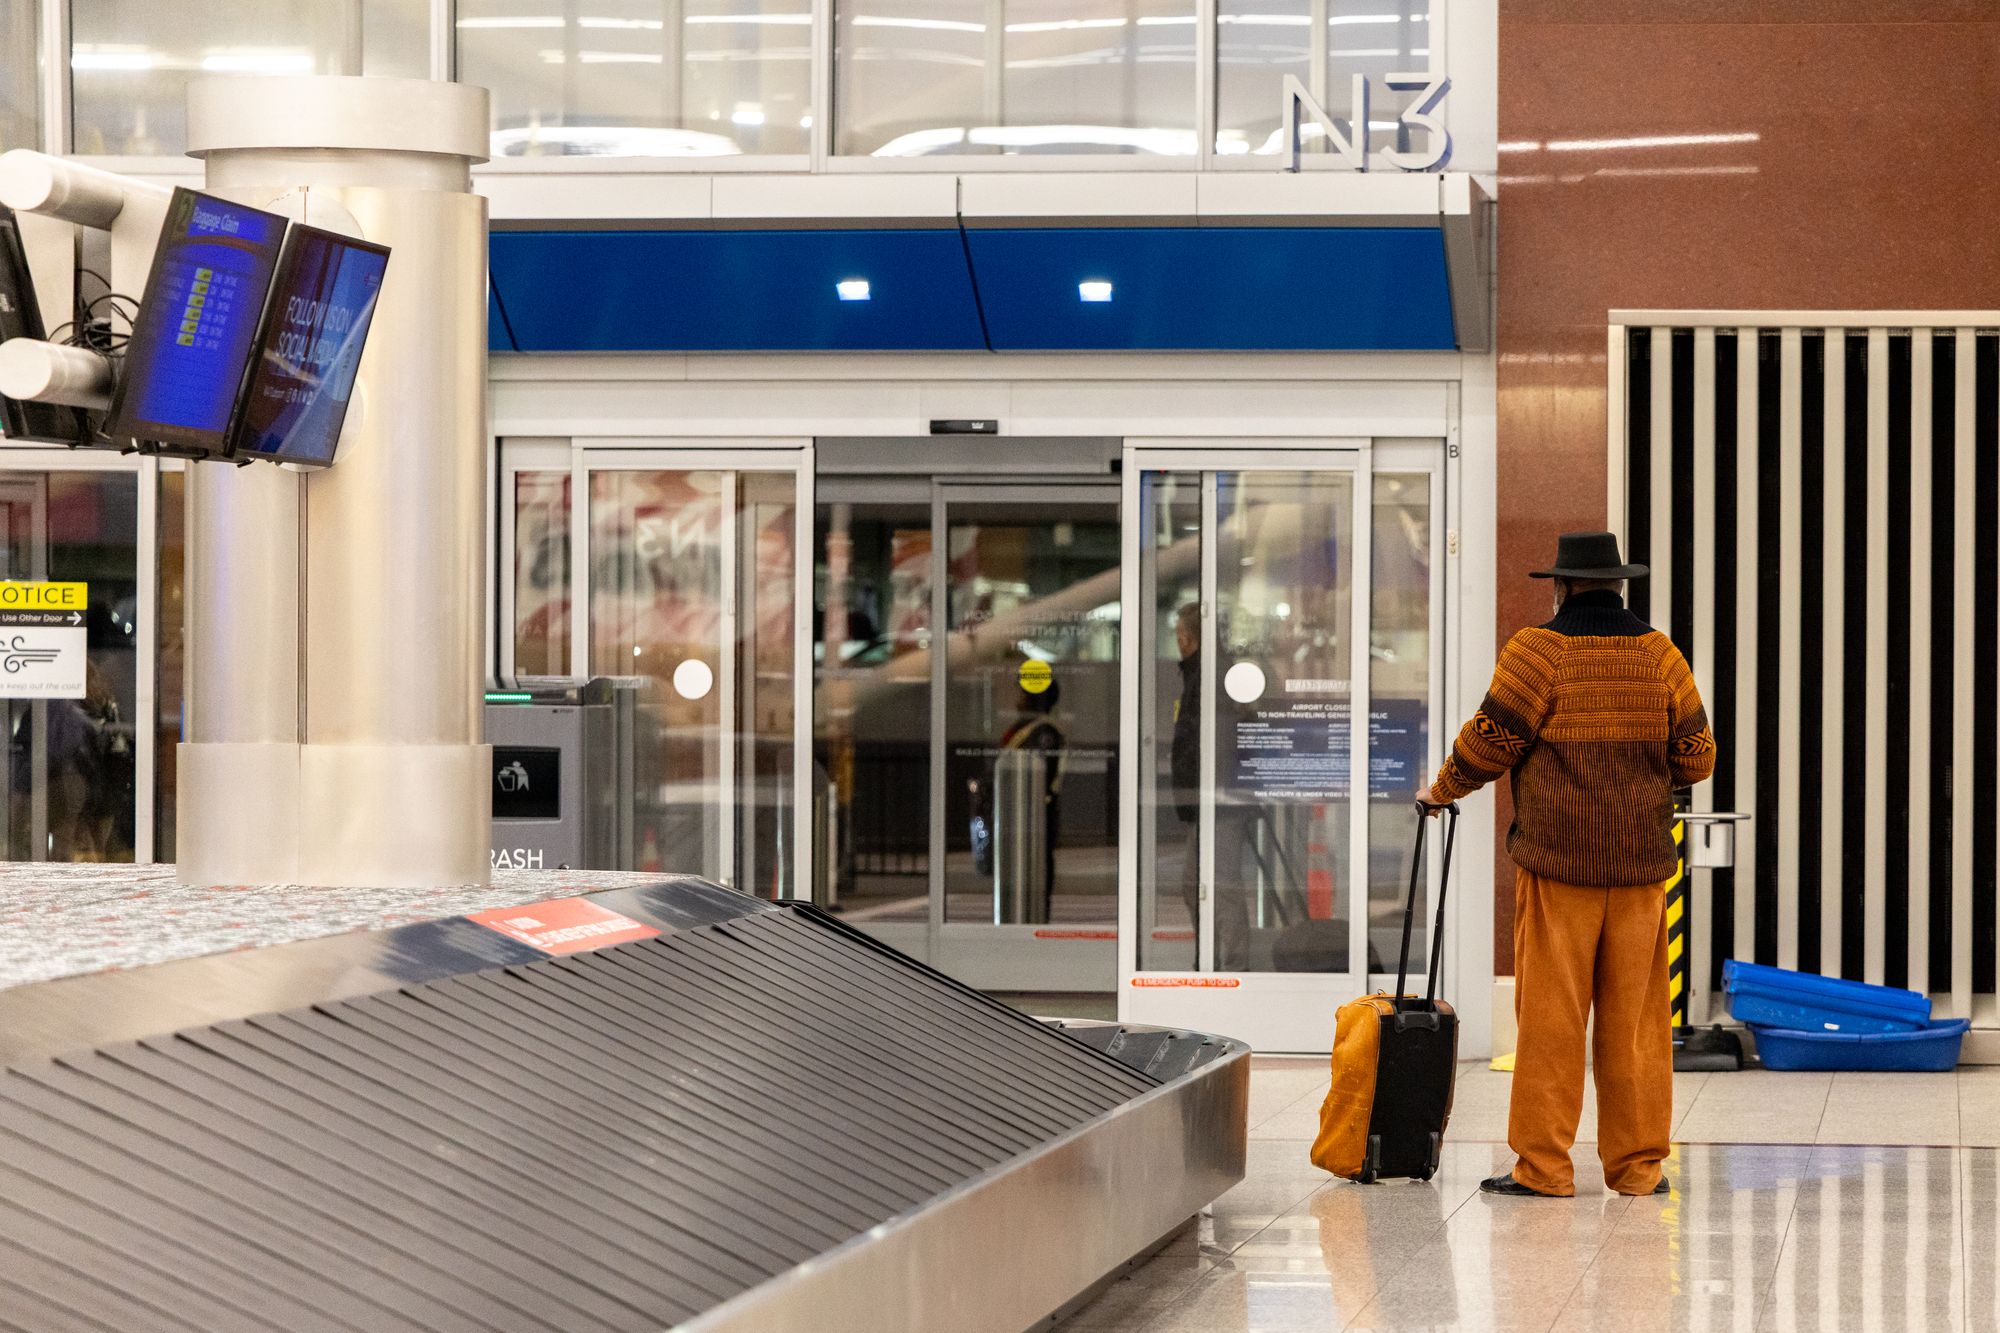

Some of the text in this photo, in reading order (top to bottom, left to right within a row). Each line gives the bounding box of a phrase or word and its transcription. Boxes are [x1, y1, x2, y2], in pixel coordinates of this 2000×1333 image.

[1282, 72, 1452, 173] N3
[191, 206, 240, 234] Baggage Claim
[286, 295, 354, 332] FOLLOW US ON
[276, 331, 338, 364] SOCIAL MEDIA
[1449, 445, 1460, 458] B
[2, 587, 75, 604] OTICE
[2, 613, 64, 622] Use Other Door
[28, 682, 43, 690] out
[46, 682, 59, 690] the
[490, 848, 543, 869] RASH
